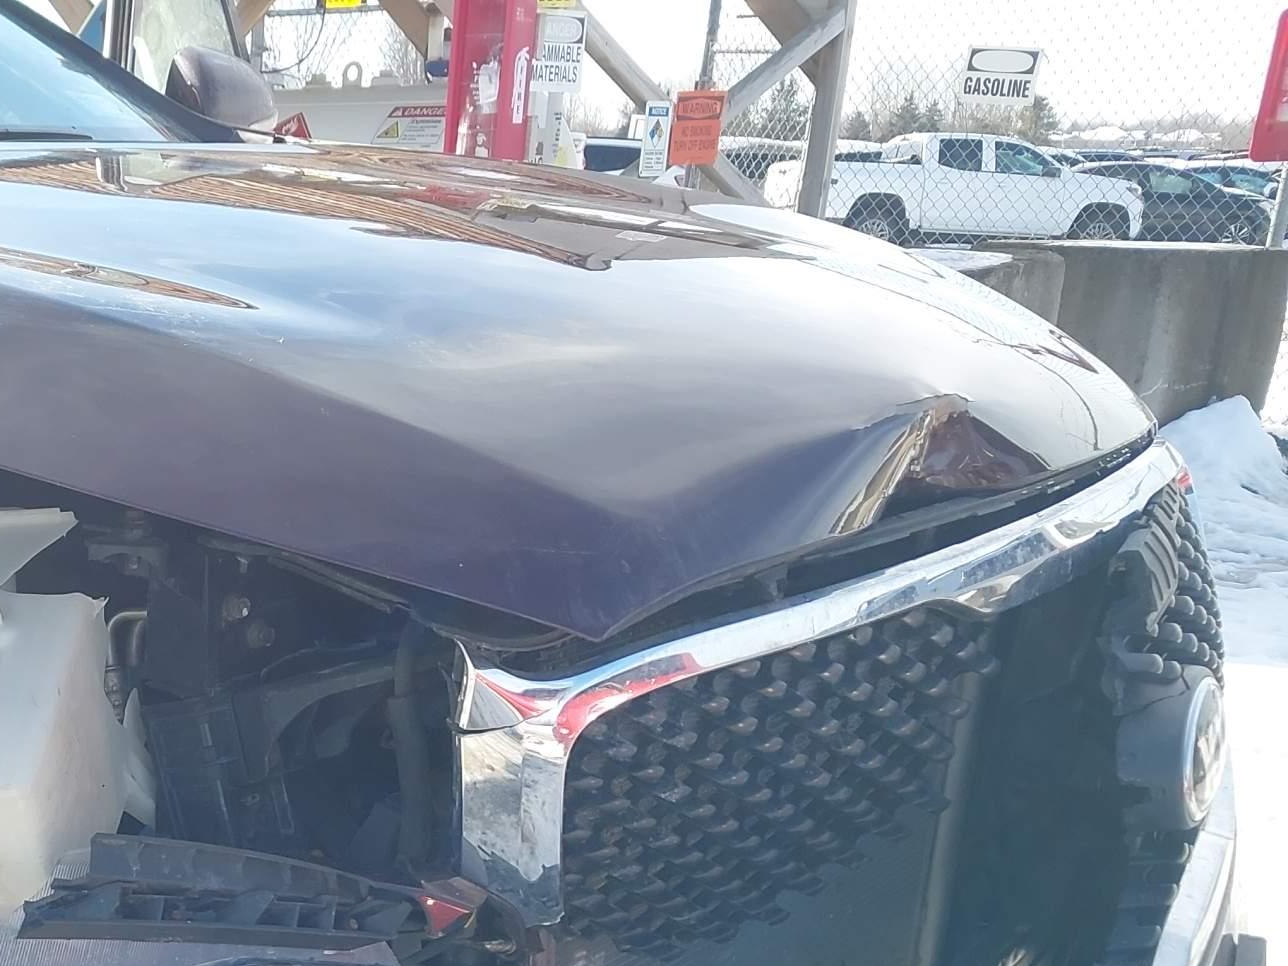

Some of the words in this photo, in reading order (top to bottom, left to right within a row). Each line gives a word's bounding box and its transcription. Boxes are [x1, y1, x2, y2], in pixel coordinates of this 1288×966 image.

[542, 45, 581, 63] AMMABLE
[531, 65, 577, 82] MATERIALS
[963, 76, 1031, 98] GASOLINE
[403, 107, 446, 116] DANGE
[681, 102, 718, 114] WARNING
